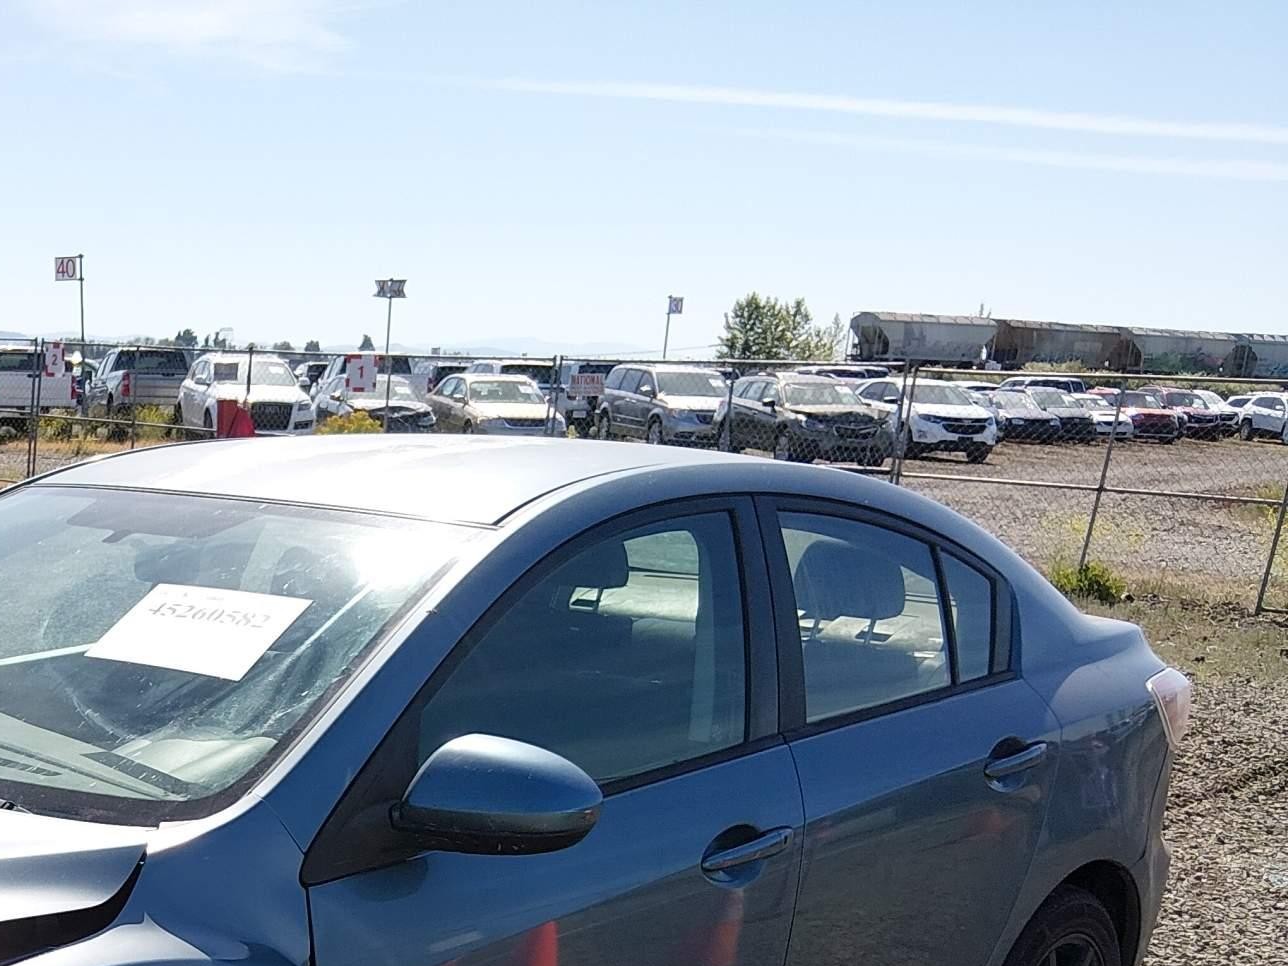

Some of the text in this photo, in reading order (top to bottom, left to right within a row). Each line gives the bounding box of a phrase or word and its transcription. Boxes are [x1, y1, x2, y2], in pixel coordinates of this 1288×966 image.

[57, 258, 75, 278] 40
[52, 353, 58, 367] 2
[357, 365, 364, 379] 1
[148, 602, 272, 629] 45260582
